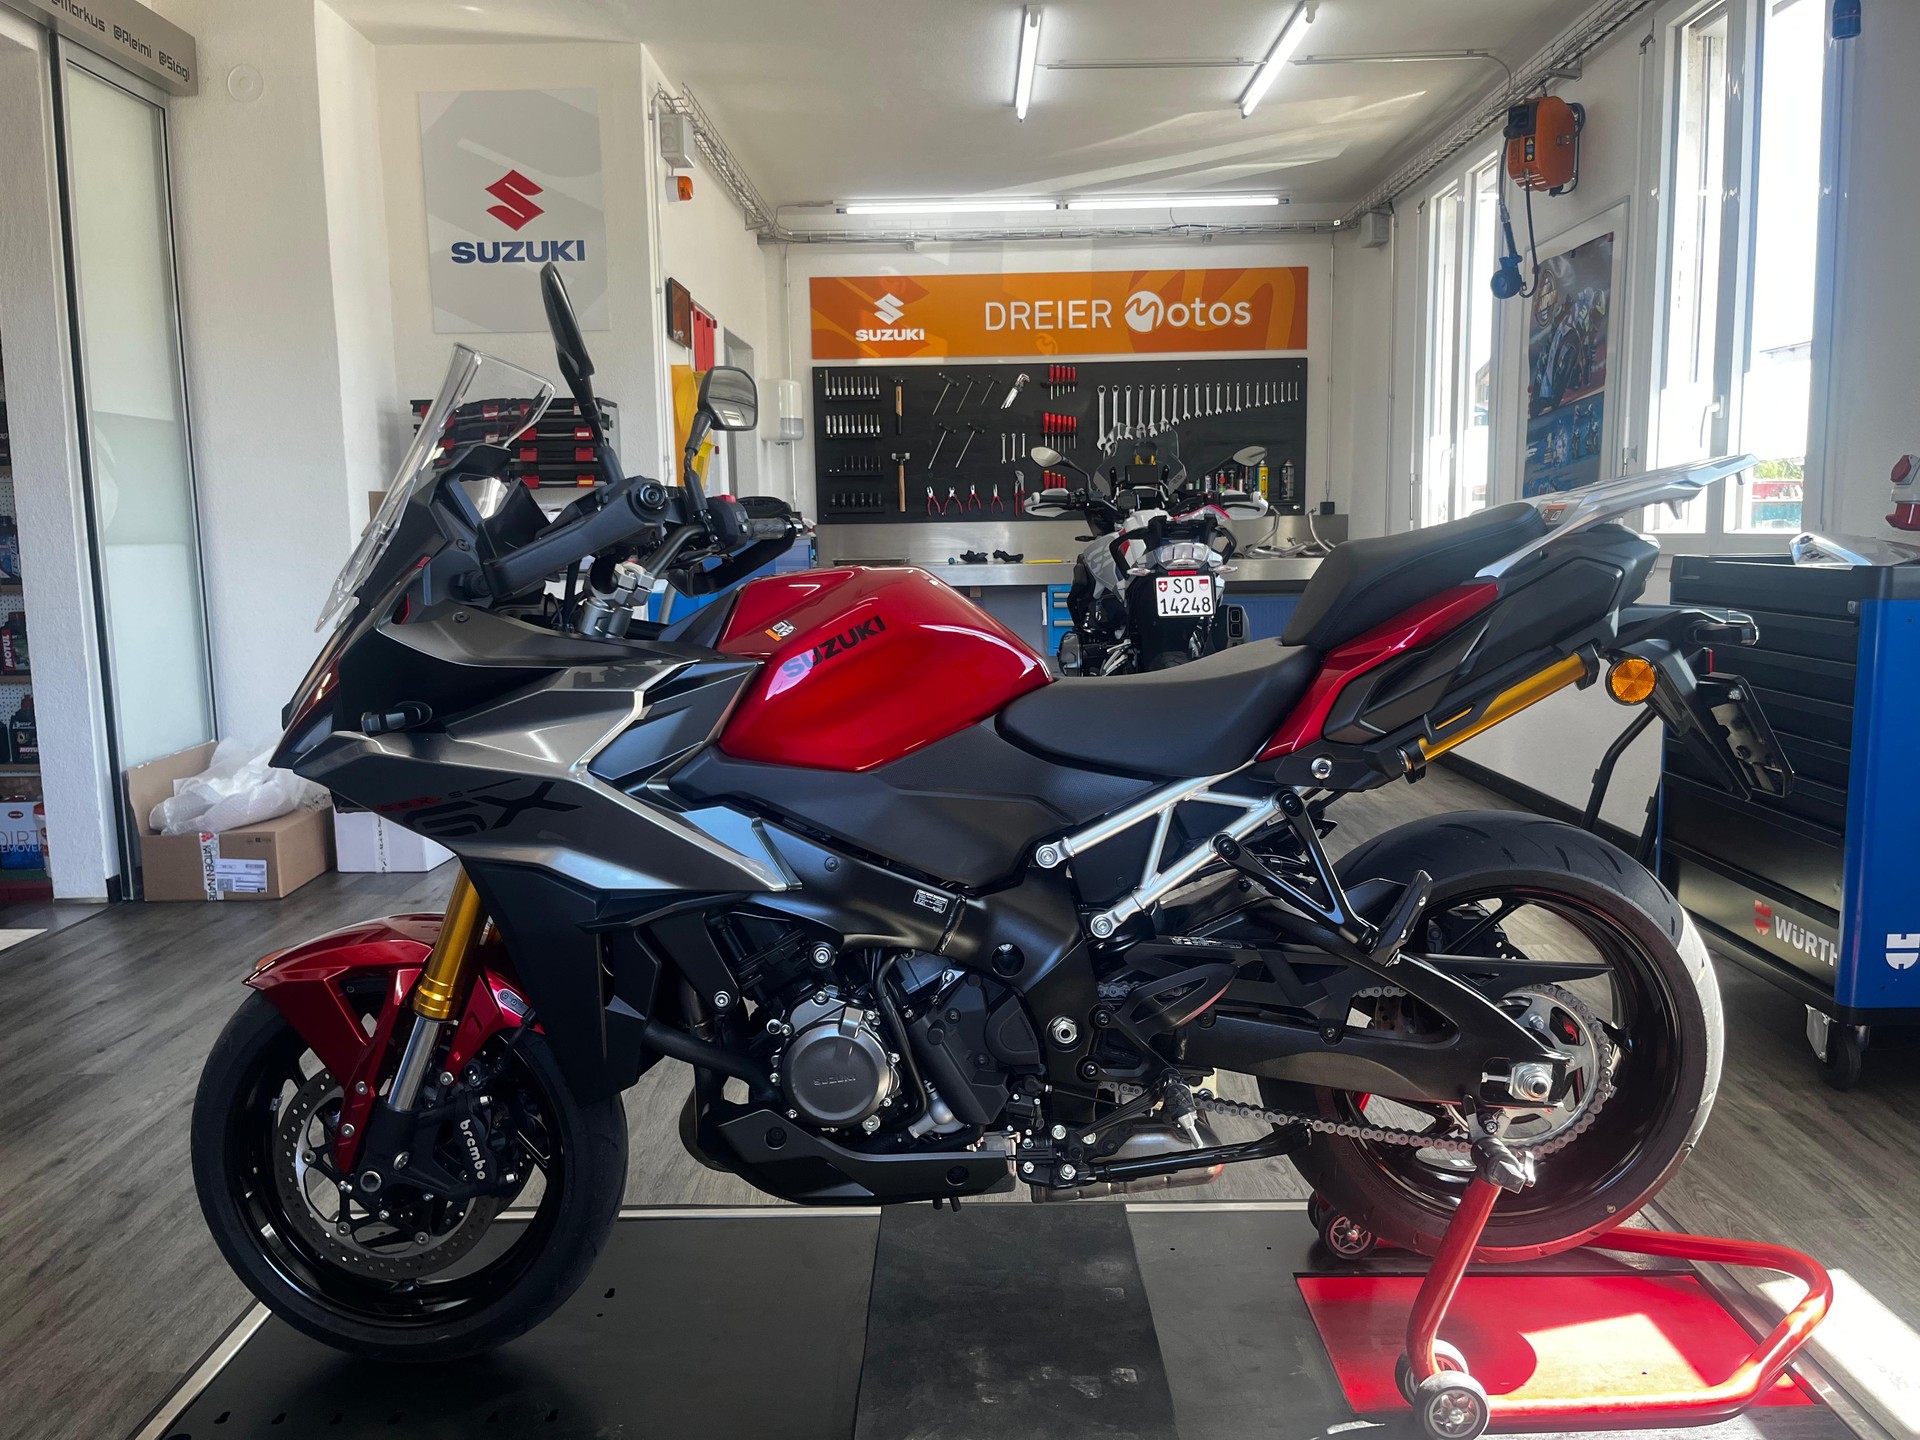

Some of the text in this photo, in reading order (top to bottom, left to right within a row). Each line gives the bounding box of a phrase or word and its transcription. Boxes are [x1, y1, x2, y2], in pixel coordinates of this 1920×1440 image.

[113, 24, 152, 59] @Pleimi
[451, 240, 586, 264] SUZUKI
[985, 290, 1251, 333] DREIER Motos
[855, 328, 925, 342] SUZUKI
[1173, 578, 1195, 594] SO
[1160, 596, 1212, 615] 14248
[3, 634, 14, 668] MOTUL
[782, 615, 887, 678] SUZUKI
[0, 844, 42, 853] EMOVE
[1775, 915, 1838, 967] WÜRTH
[459, 1119, 487, 1181] brembo
